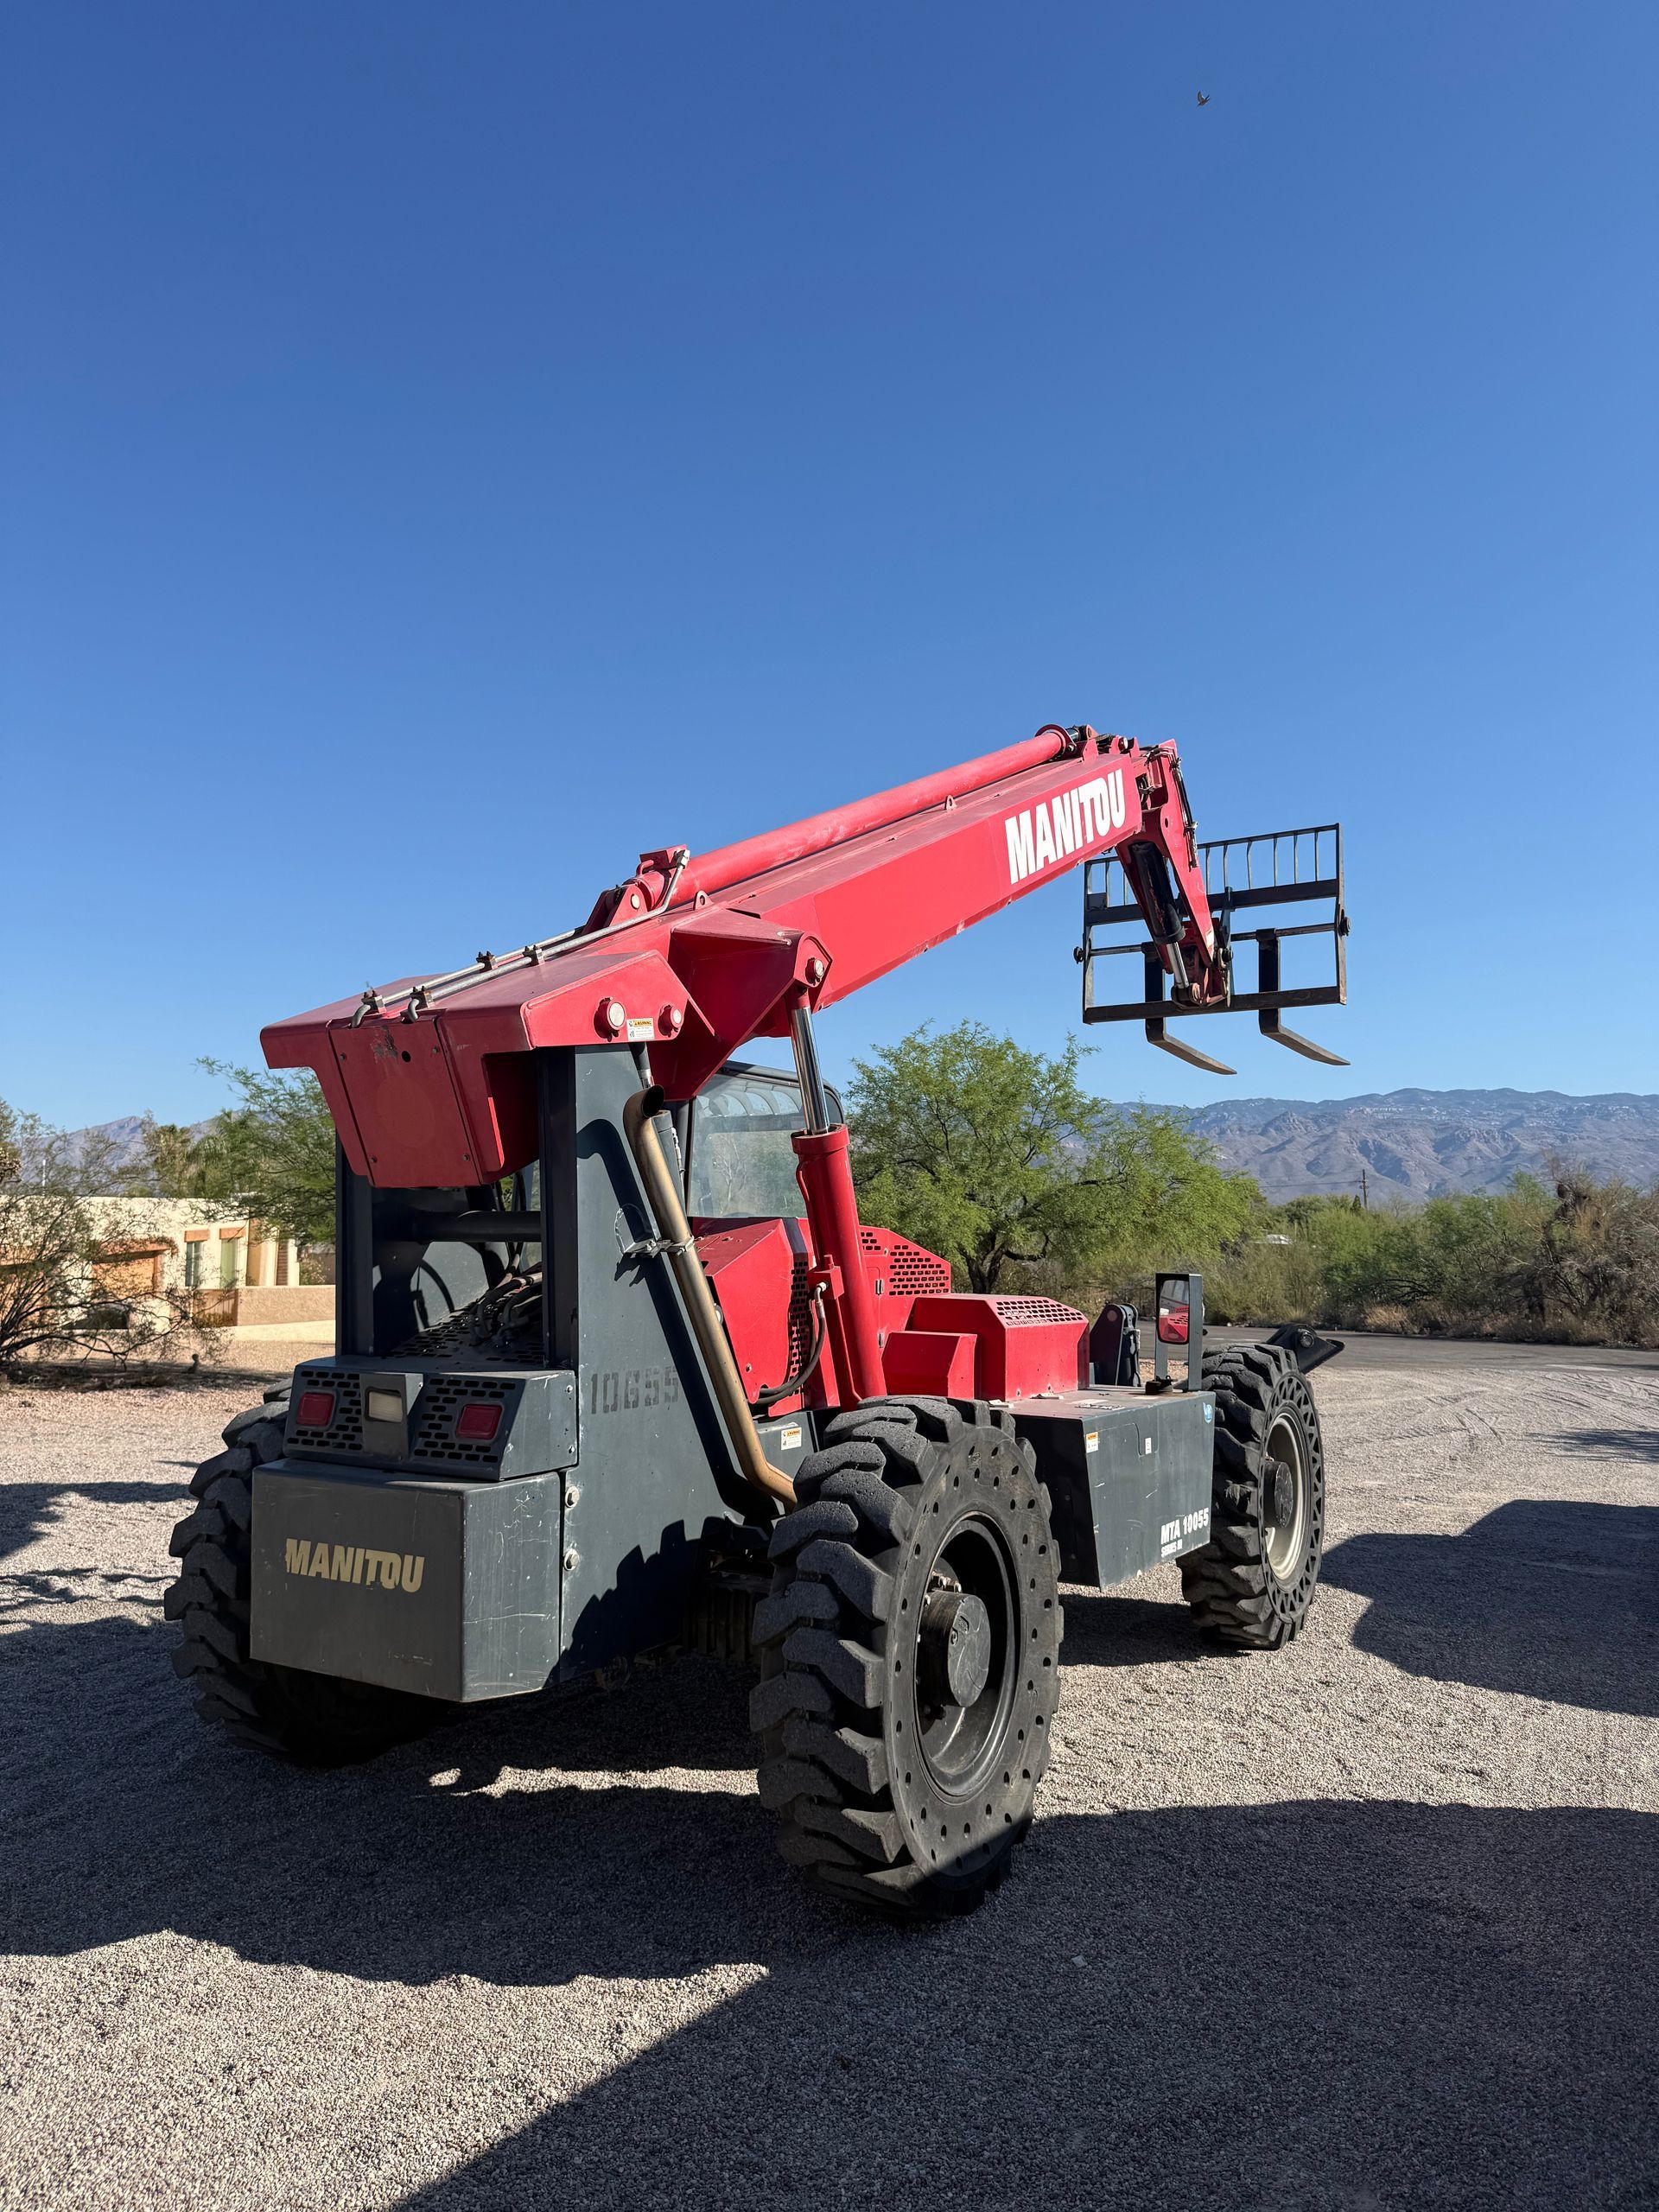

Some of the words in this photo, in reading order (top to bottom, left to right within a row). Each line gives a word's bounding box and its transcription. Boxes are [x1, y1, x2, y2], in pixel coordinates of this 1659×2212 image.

[1004, 768, 1126, 886] MANITOU
[1160, 1519, 1181, 1545] MTA
[1183, 1507, 1209, 1535] 10055
[285, 1538, 425, 1593] MANITOU
